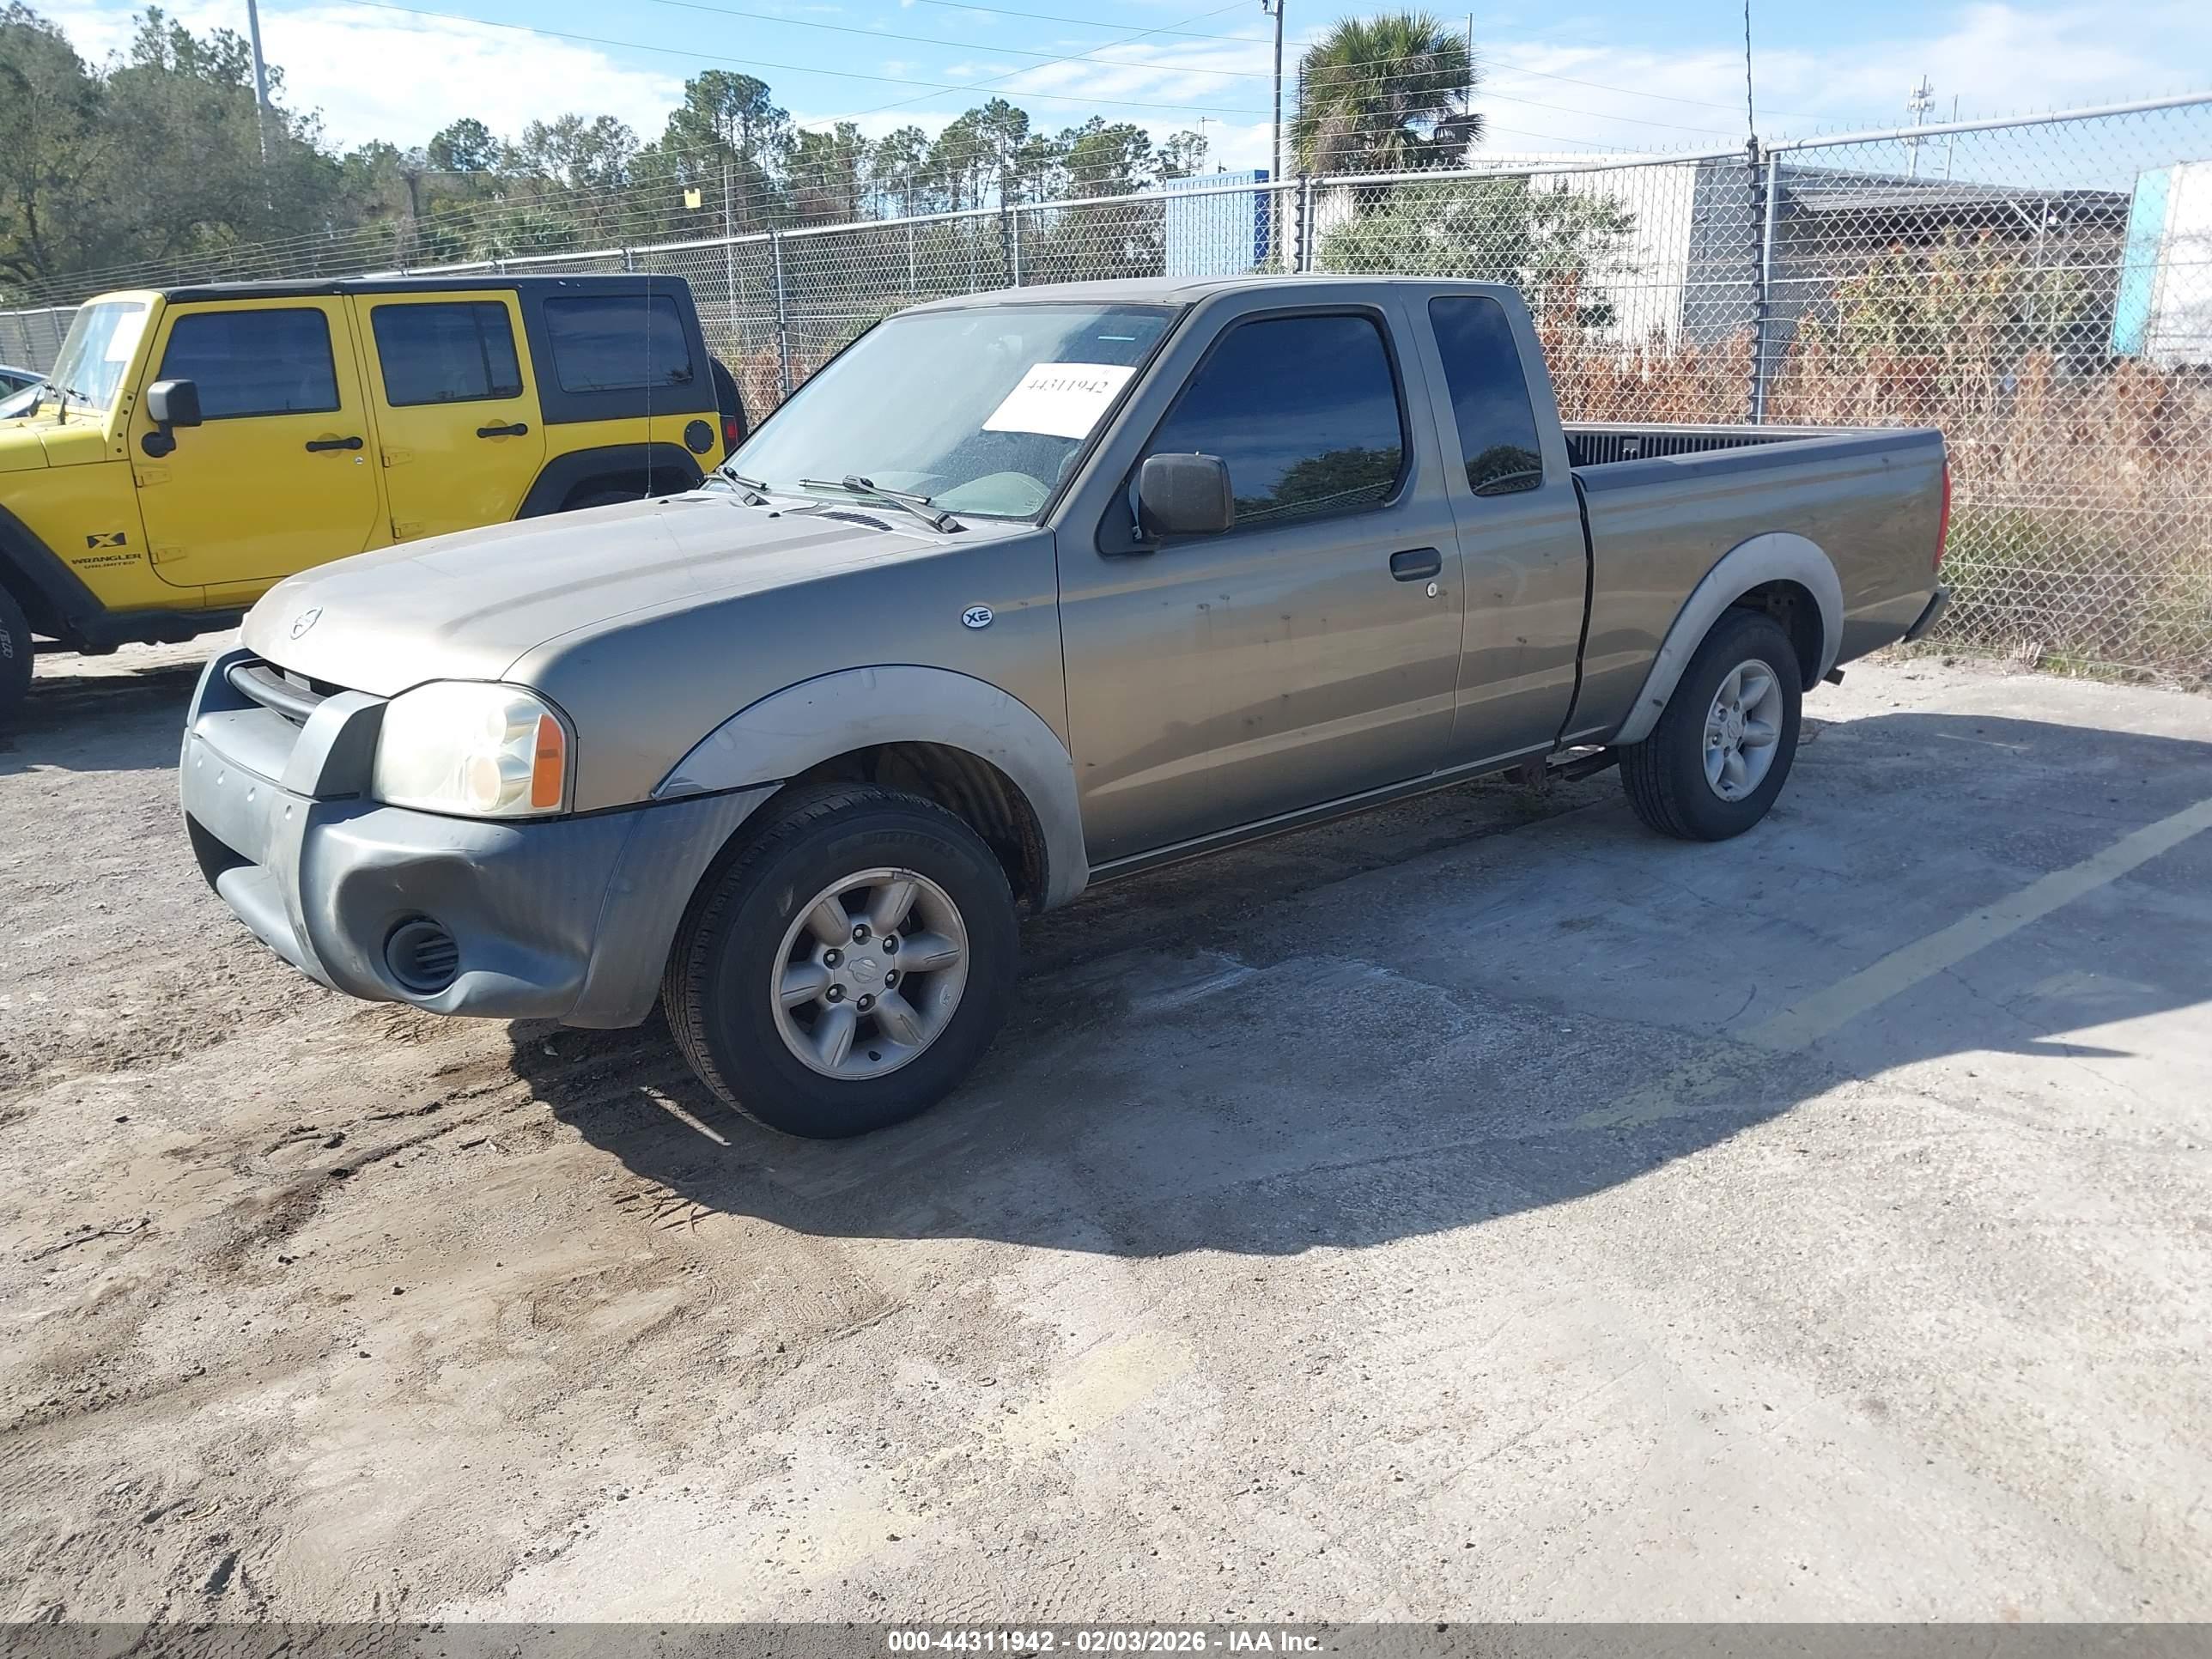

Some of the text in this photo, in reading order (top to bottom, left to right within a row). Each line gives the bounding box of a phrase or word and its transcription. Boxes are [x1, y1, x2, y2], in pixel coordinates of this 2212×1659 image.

[1028, 379, 1109, 393] 44311942
[71, 553, 142, 564] WRANGLER
[84, 561, 135, 569] UNLIMITED
[965, 610, 990, 624] XE
